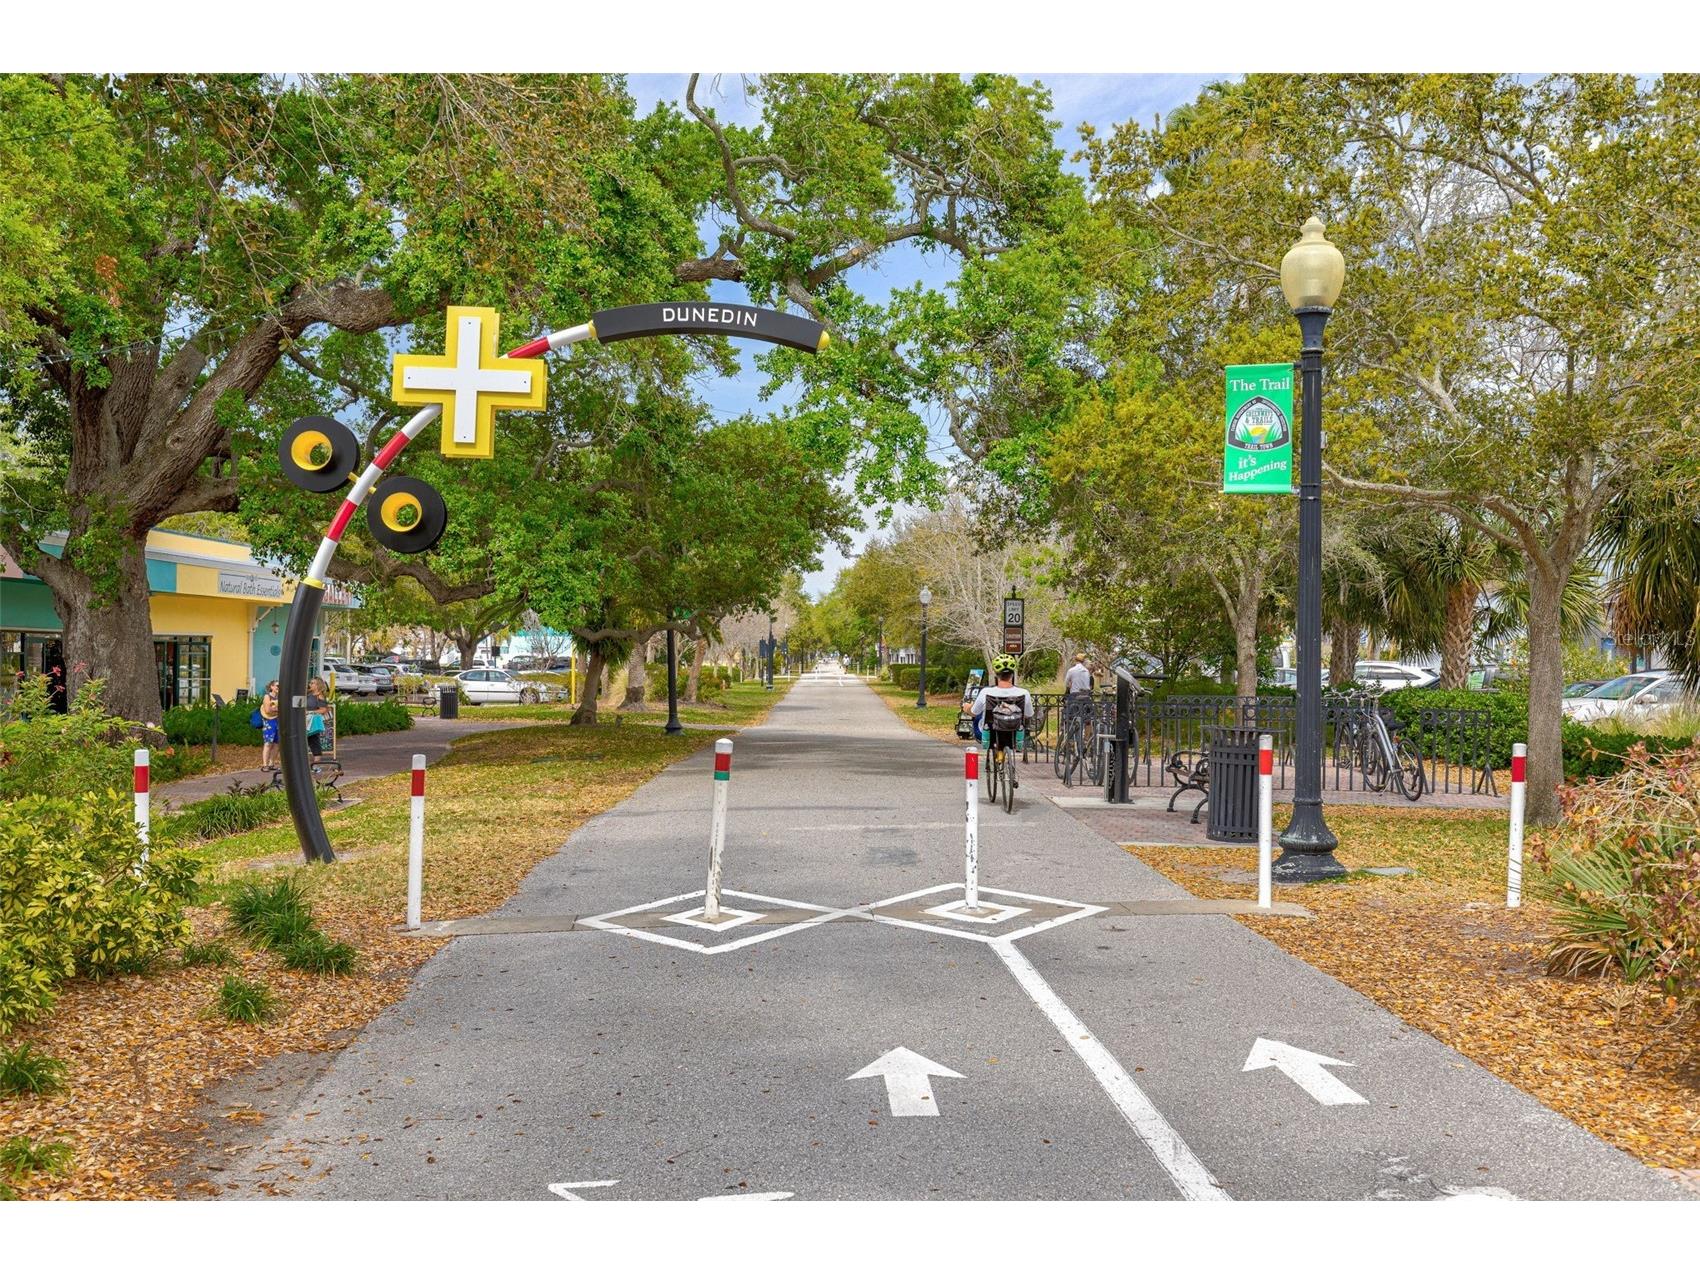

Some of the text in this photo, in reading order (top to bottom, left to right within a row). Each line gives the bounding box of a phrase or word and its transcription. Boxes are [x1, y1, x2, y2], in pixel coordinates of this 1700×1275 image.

[662, 307, 758, 327] DUNEDIN
[1229, 377, 1290, 391] The Trail
[1238, 454, 1257, 469] it's
[1229, 460, 1287, 482] Happening
[220, 581, 282, 598] Natural Bath Essentials
[1008, 613, 1020, 623] 20
